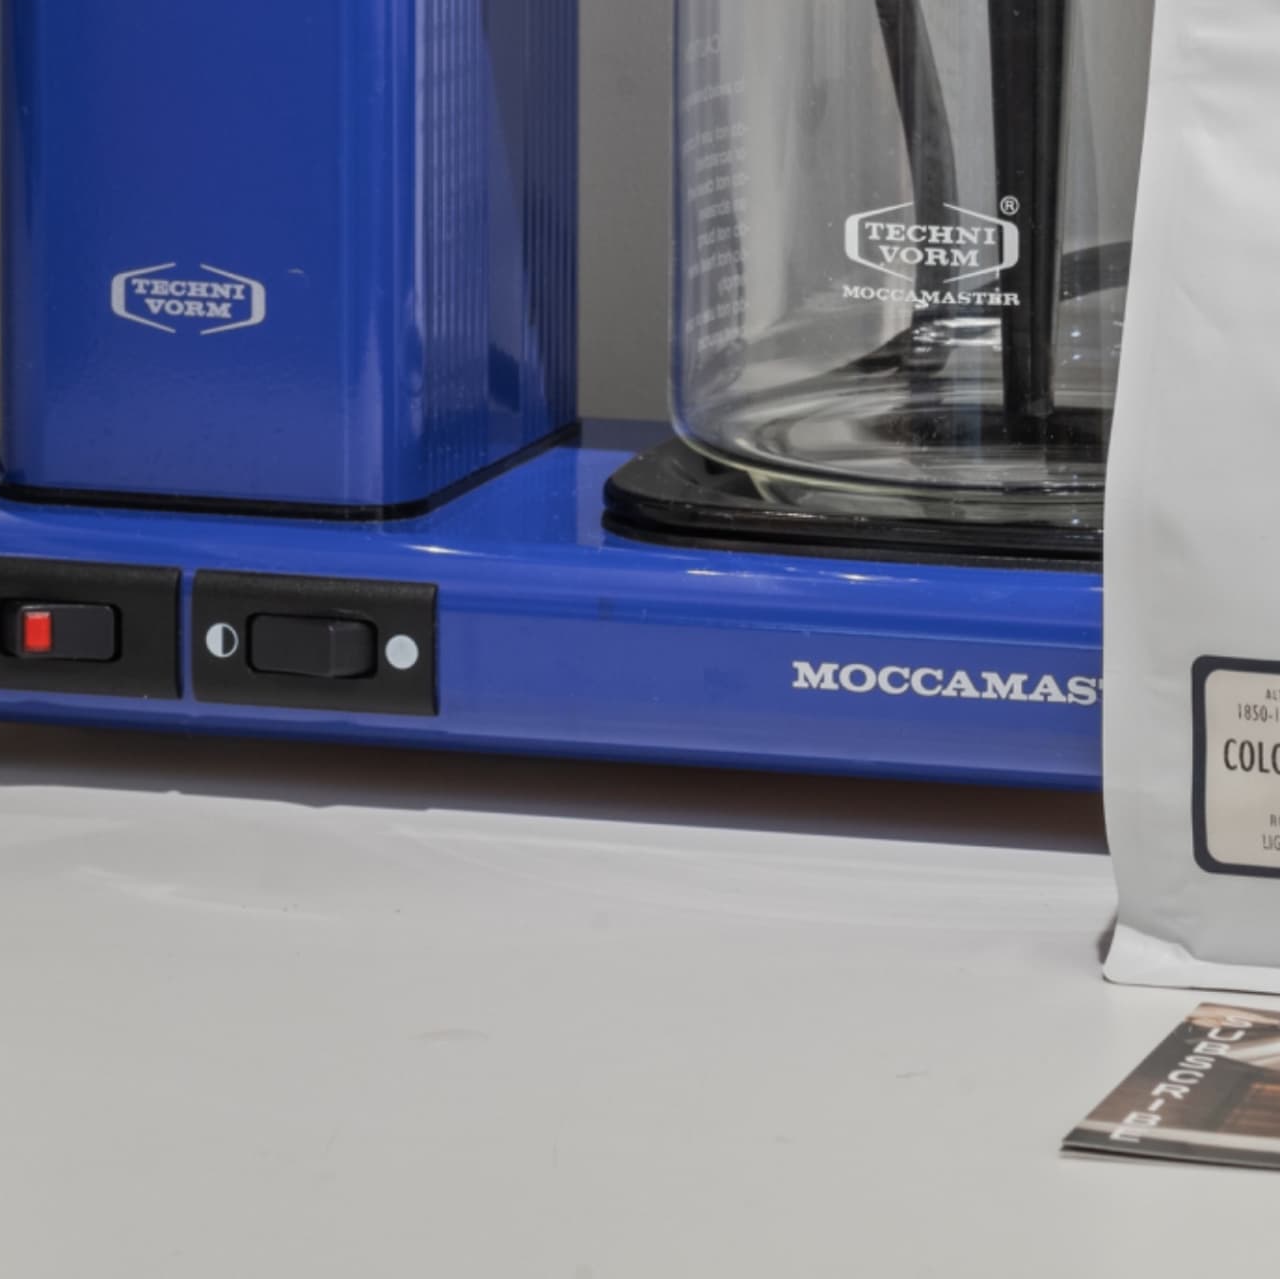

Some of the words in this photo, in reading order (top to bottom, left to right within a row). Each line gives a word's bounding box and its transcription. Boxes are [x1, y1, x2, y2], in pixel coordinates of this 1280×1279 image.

[865, 222, 996, 245] TECHNI
[879, 245, 979, 267] VORM
[131, 278, 245, 300] TECHNI
[842, 285, 1020, 306] MOCCAMASTER
[144, 298, 232, 319] VORM
[792, 661, 1103, 706] MOCCAMAS
